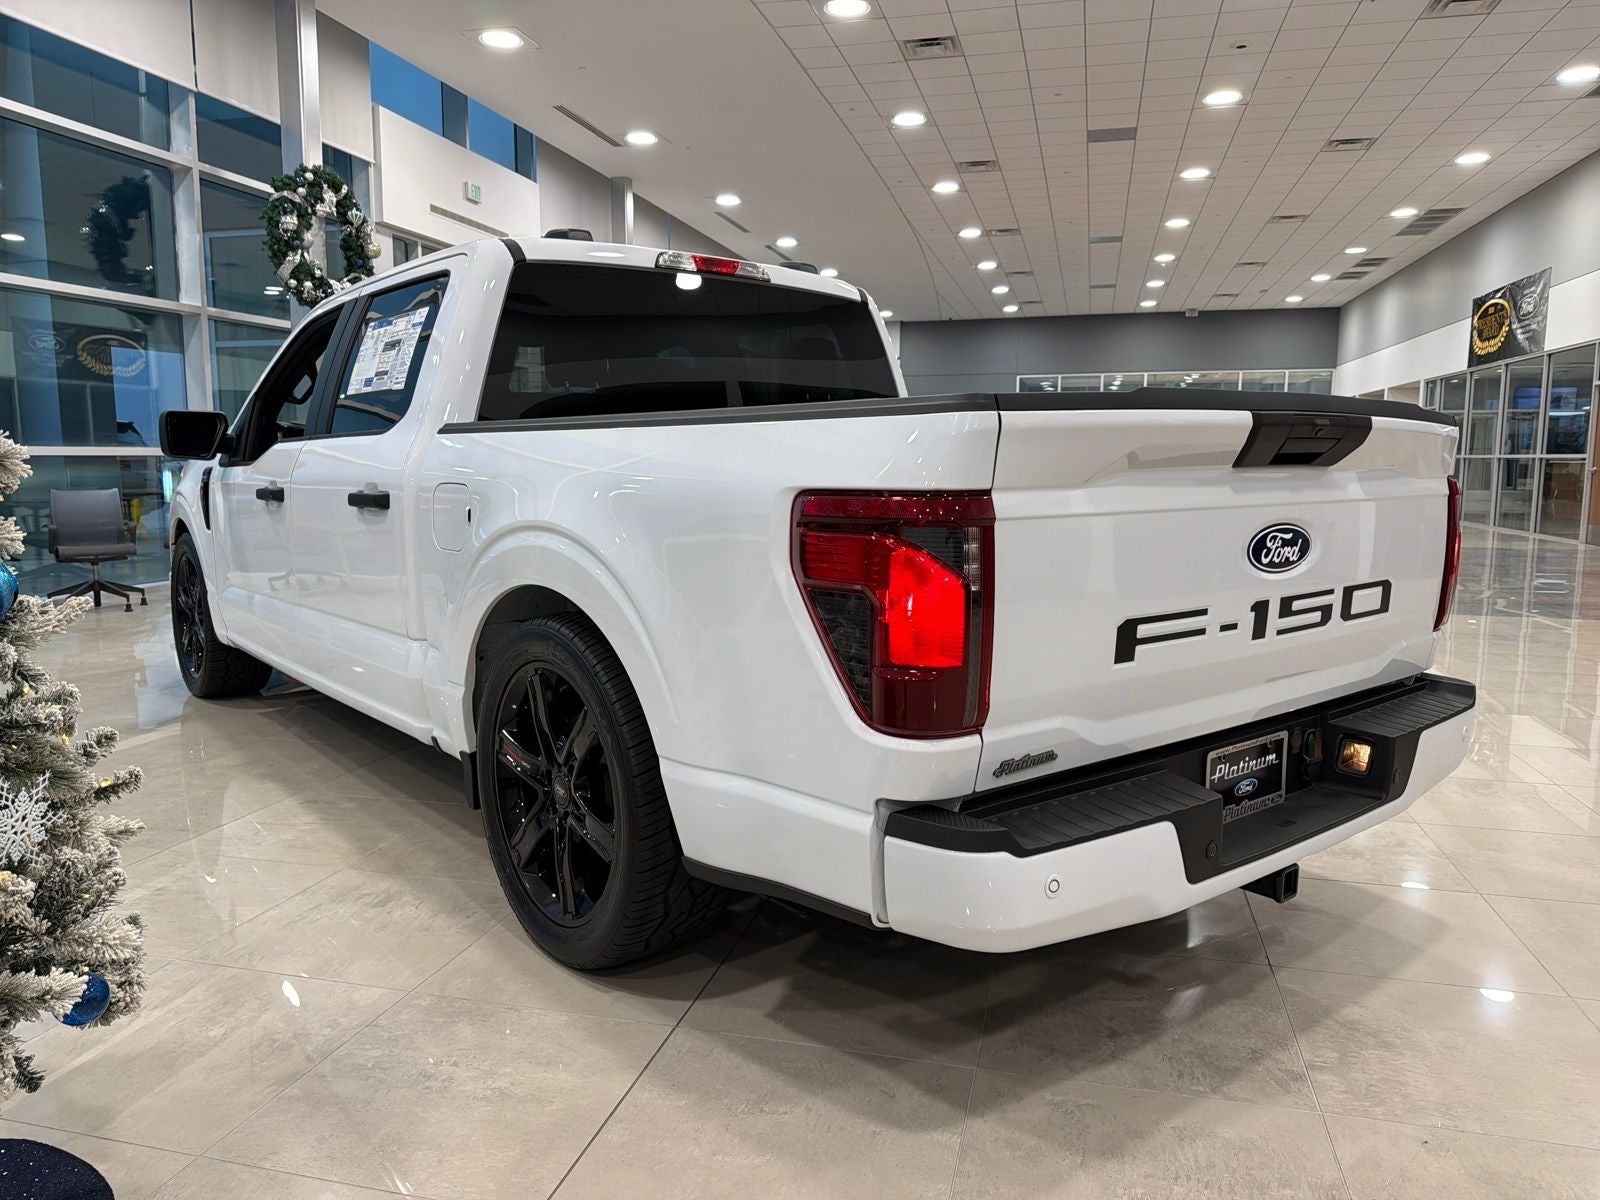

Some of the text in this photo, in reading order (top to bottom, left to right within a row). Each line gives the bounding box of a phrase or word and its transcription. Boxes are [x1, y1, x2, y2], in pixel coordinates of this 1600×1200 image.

[1260, 532, 1302, 564] Ford
[1113, 579, 1392, 665] F-150
[993, 750, 1059, 778] Platinum
[1210, 753, 1280, 783] Platinum
[1238, 781, 1254, 794] Ford
[1223, 801, 1268, 820] Platinum
